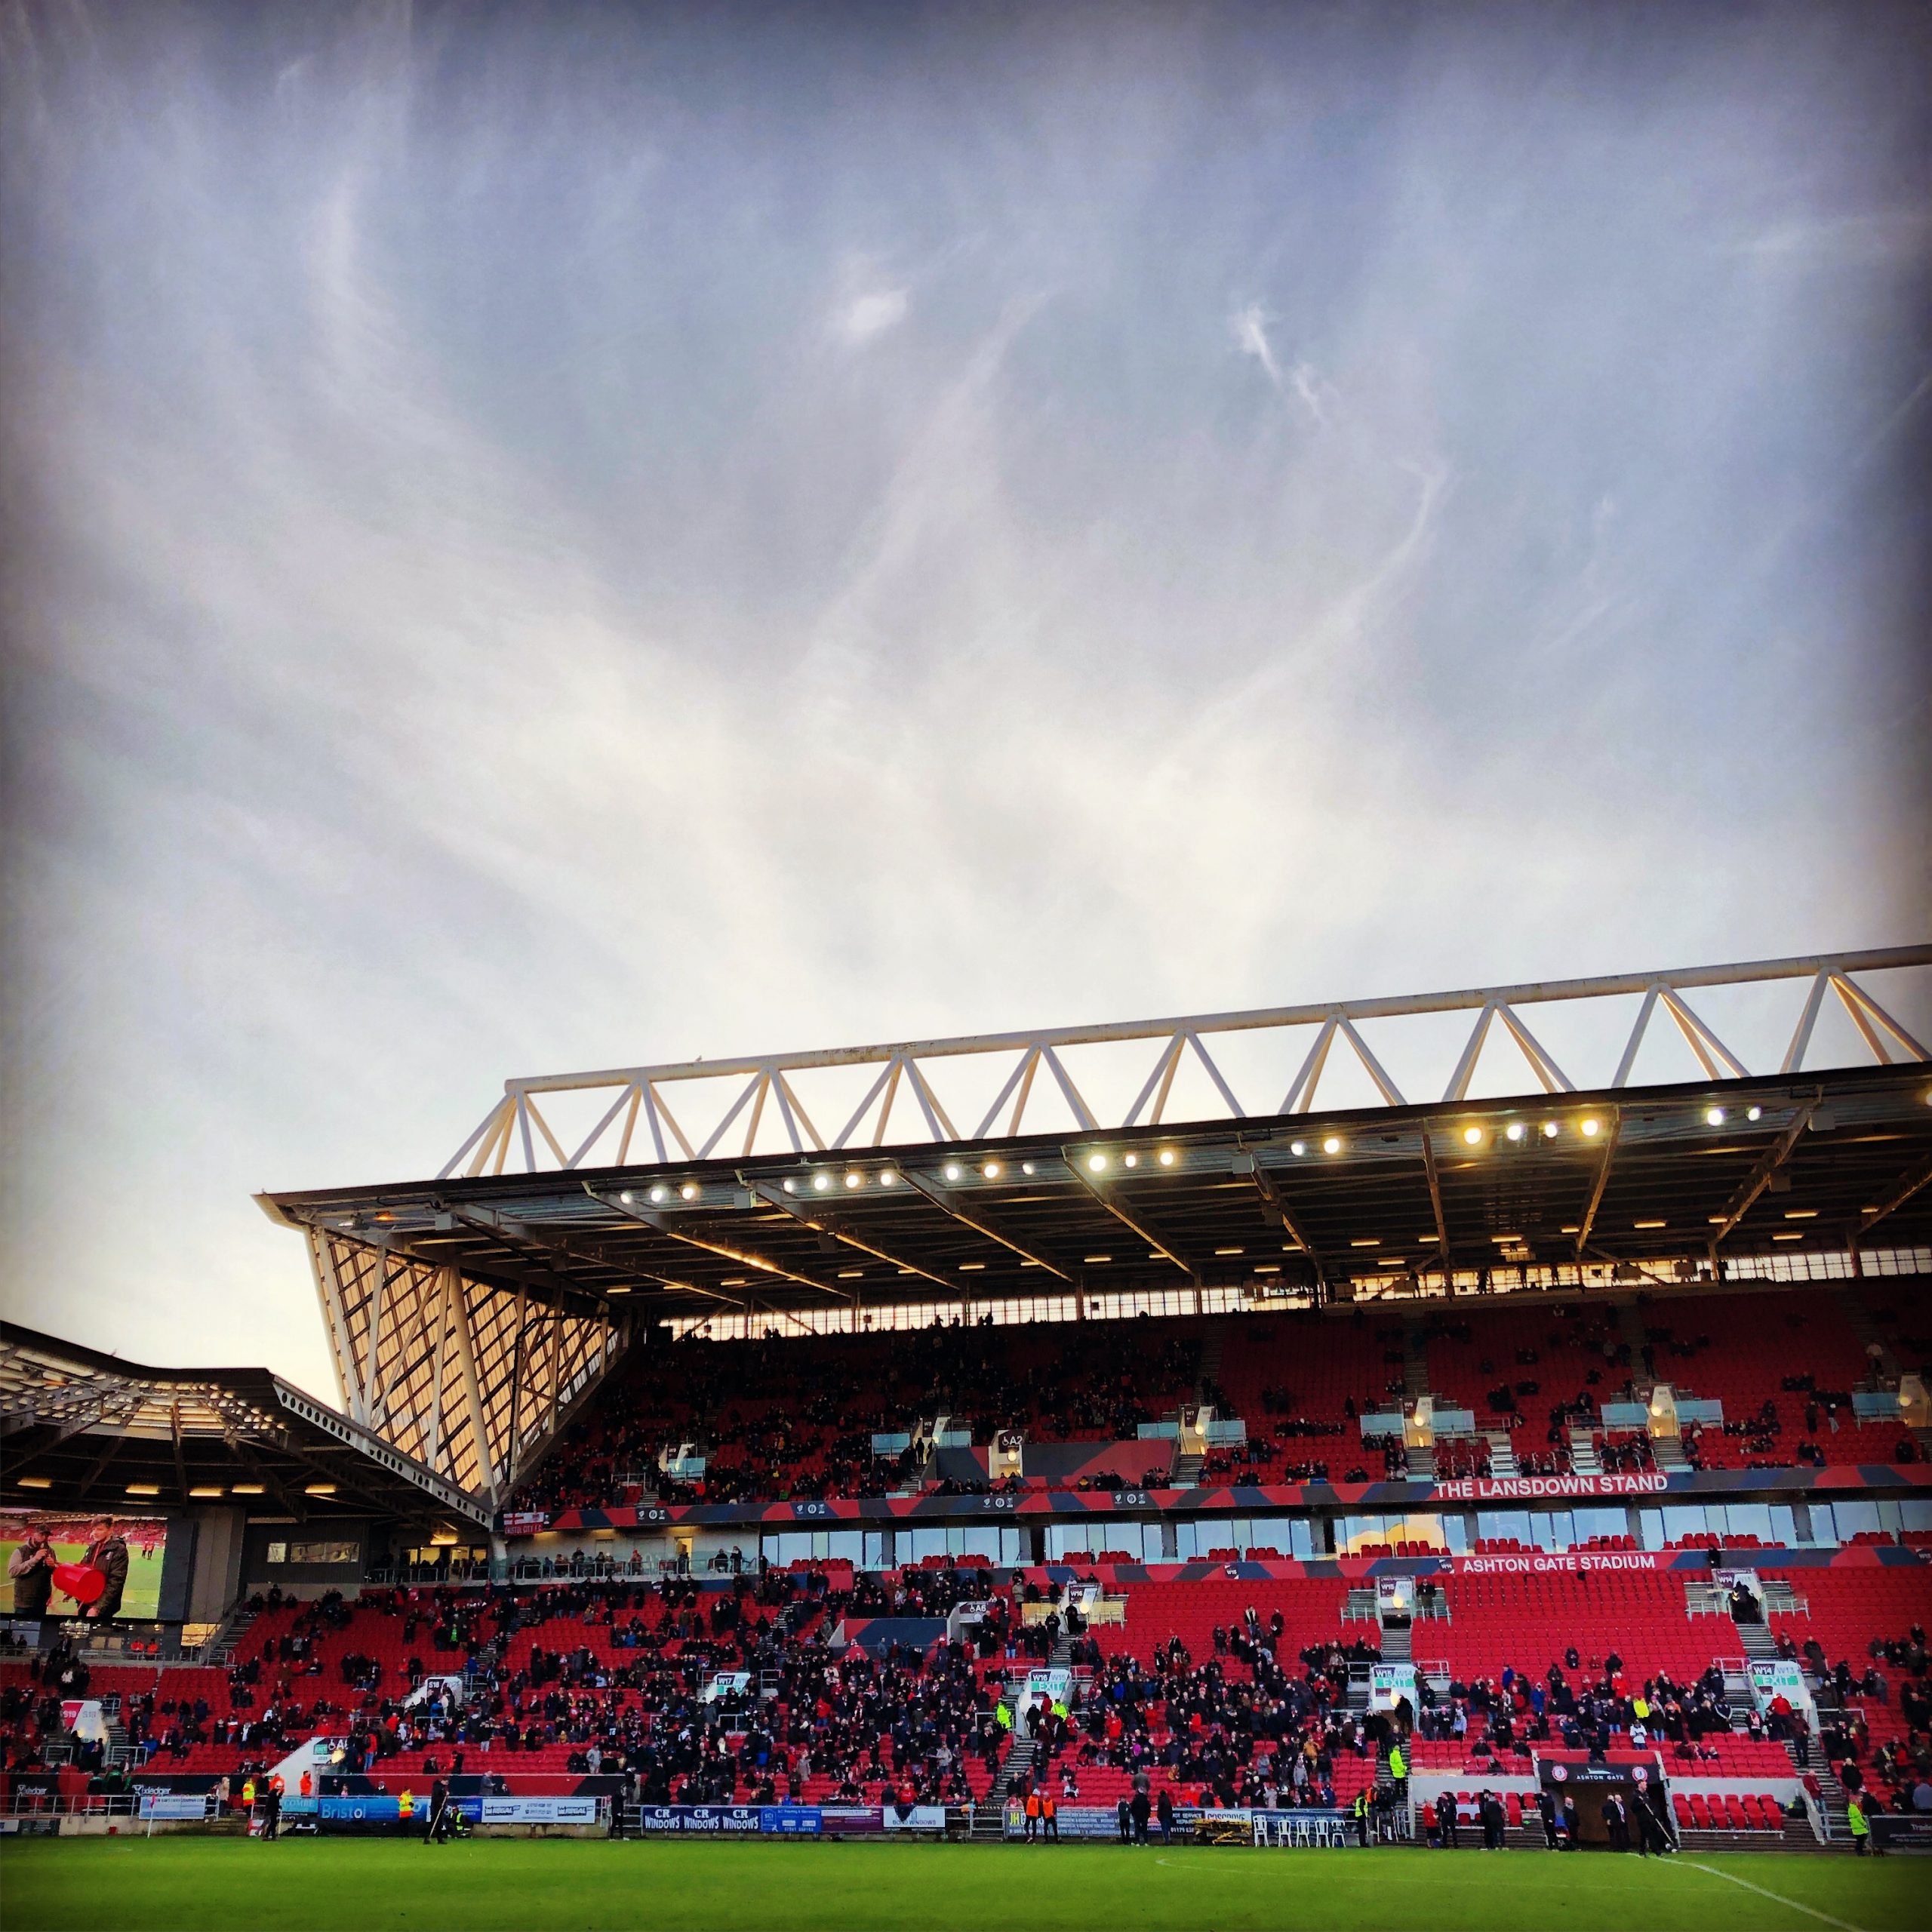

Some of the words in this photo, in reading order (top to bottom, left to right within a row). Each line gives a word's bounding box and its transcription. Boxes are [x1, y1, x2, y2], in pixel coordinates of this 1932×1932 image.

[1009, 1435, 1023, 1445] A2
[1435, 1481, 1473, 1498] THE
[1478, 1478, 1595, 1497] LANSDOWN
[1599, 1475, 1668, 1493] STAND
[1463, 1558, 1530, 1573] ASHTON
[1534, 1557, 1577, 1571] GATE
[1580, 1555, 1656, 1570] STADIUM
[1375, 1669, 1394, 1678] W15
[1753, 1666, 1773, 1675] W14
[1383, 1678, 1407, 1687] EXIT
[1764, 1675, 1791, 1685] EXIT
[1038, 1682, 1065, 1691] EXIT
[321, 1804, 366, 1819] Bristol
[654, 1808, 670, 1819] CR
[694, 1808, 709, 1819] CR
[732, 1808, 749, 1819] CR
[645, 1815, 680, 1829] WINDOWS
[684, 1815, 719, 1829] WINDOWS
[722, 1815, 758, 1829] WINDOWS
[1009, 1812, 1020, 1825] JH
